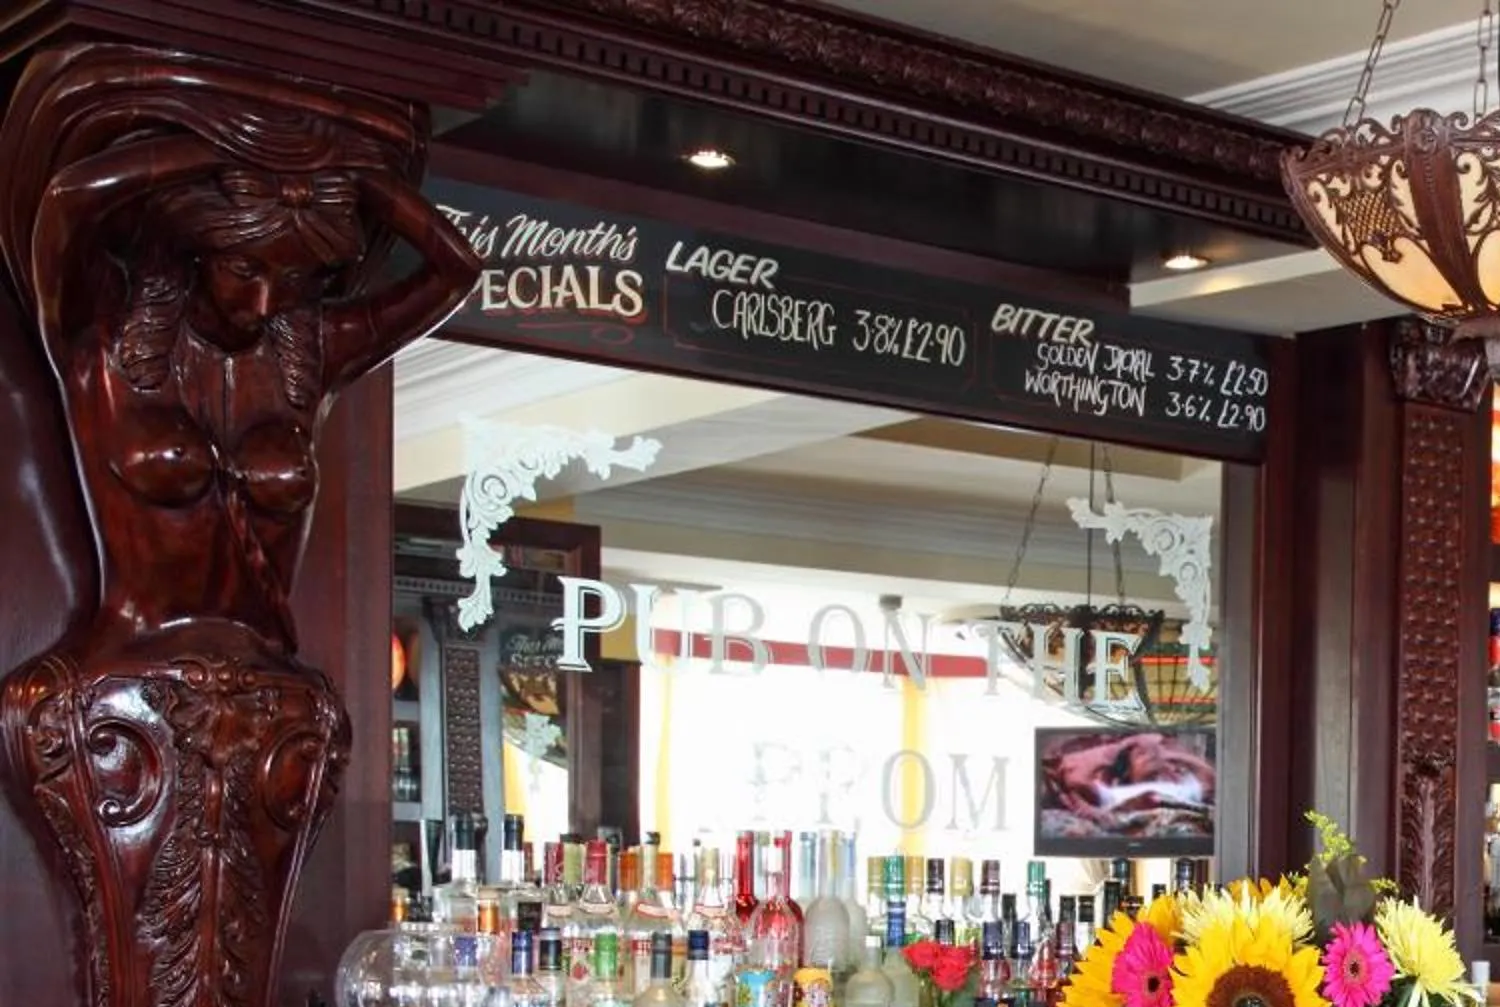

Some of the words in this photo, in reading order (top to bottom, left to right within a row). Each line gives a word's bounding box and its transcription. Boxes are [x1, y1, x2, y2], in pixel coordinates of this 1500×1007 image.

[435, 204, 498, 258] Tis
[501, 213, 638, 262] Month's
[480, 264, 644, 317] ECIALS
[665, 240, 780, 289] LAGER
[712, 289, 836, 351] CARLSBERG
[902, 317, 966, 367] £2.90
[991, 303, 1095, 348] BITTER
[1024, 367, 1146, 417] WORTHINGTON
[552, 575, 773, 678] PUB
[809, 602, 937, 692] ON
[956, 620, 1148, 715] THE
